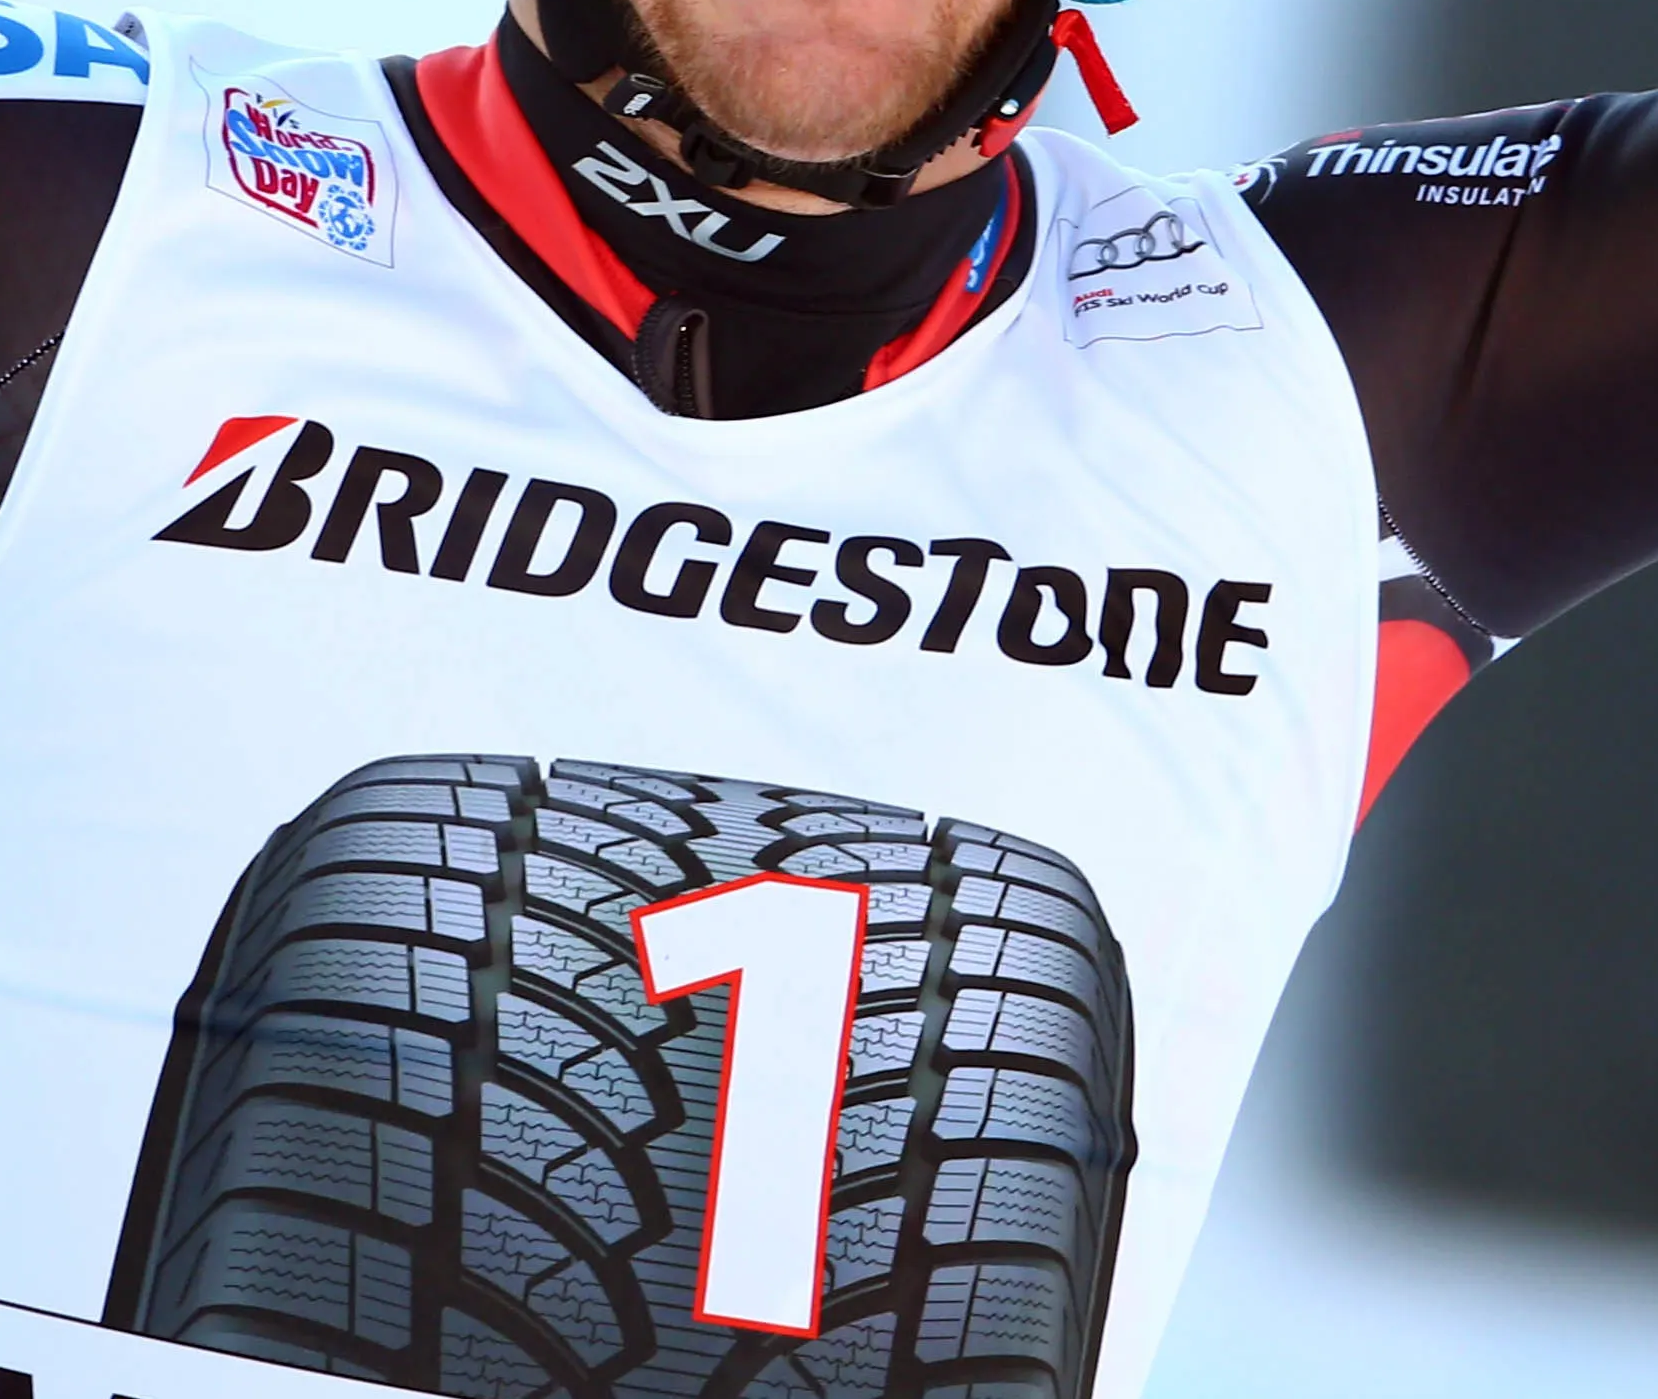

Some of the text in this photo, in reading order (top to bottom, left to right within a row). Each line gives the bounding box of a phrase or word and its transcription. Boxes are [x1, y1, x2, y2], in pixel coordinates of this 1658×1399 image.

[225, 108, 364, 188] Snow
[251, 155, 320, 214] Day
[570, 139, 787, 264] 2XU
[1073, 287, 1114, 305] Audi
[1107, 296, 1134, 308] Ski
[1138, 283, 1192, 304] World
[1197, 281, 1229, 296] Cup
[150, 414, 1272, 697] BRIDGESTONE
[629, 870, 870, 1340] 1
